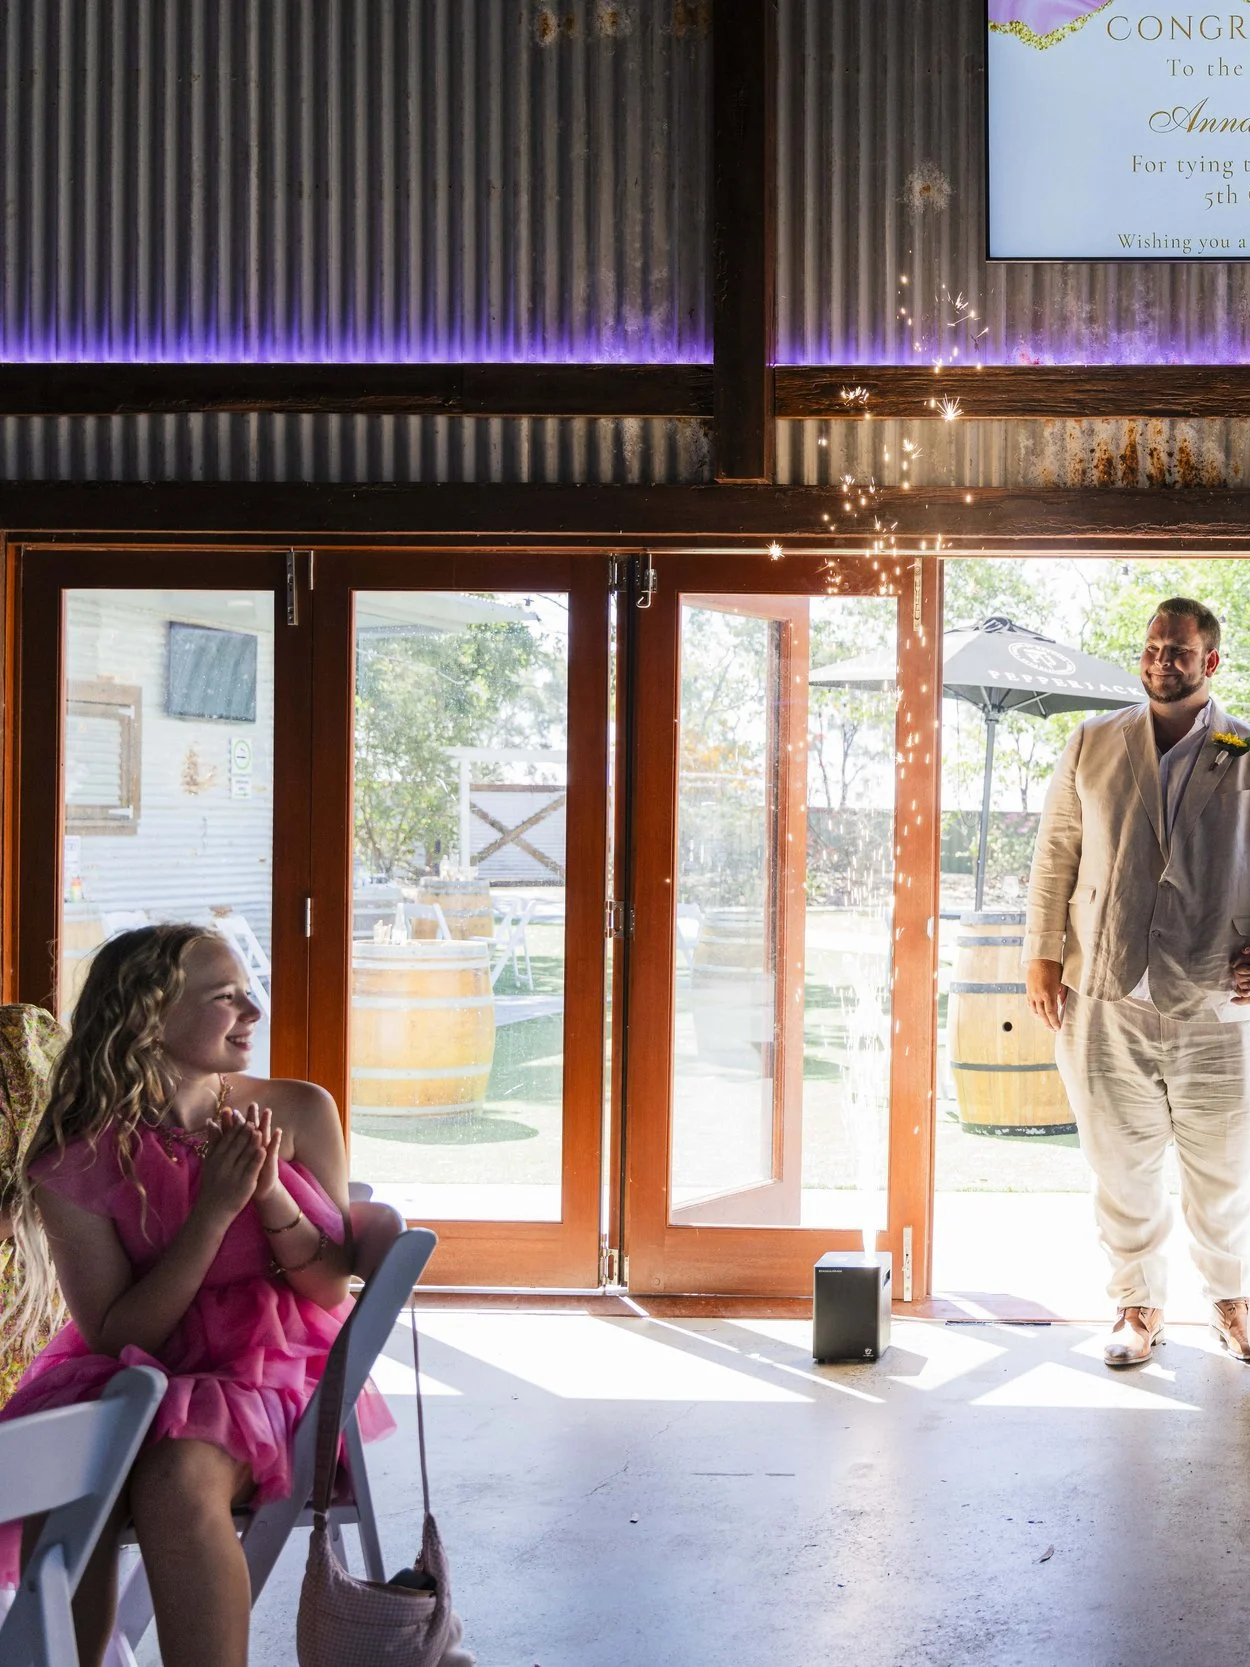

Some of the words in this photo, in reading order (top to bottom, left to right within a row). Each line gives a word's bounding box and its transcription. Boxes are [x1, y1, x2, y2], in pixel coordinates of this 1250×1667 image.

[1166, 58, 1194, 77] To
[1208, 57, 1242, 76] the
[1132, 154, 1167, 173] For
[1178, 156, 1233, 179] tying
[1205, 184, 1238, 210] 5th
[1118, 232, 1191, 254] Wishing
[1198, 238, 1230, 254] you
[1238, 238, 1246, 249] a
[988, 669, 1146, 698] PEPPERJACK
